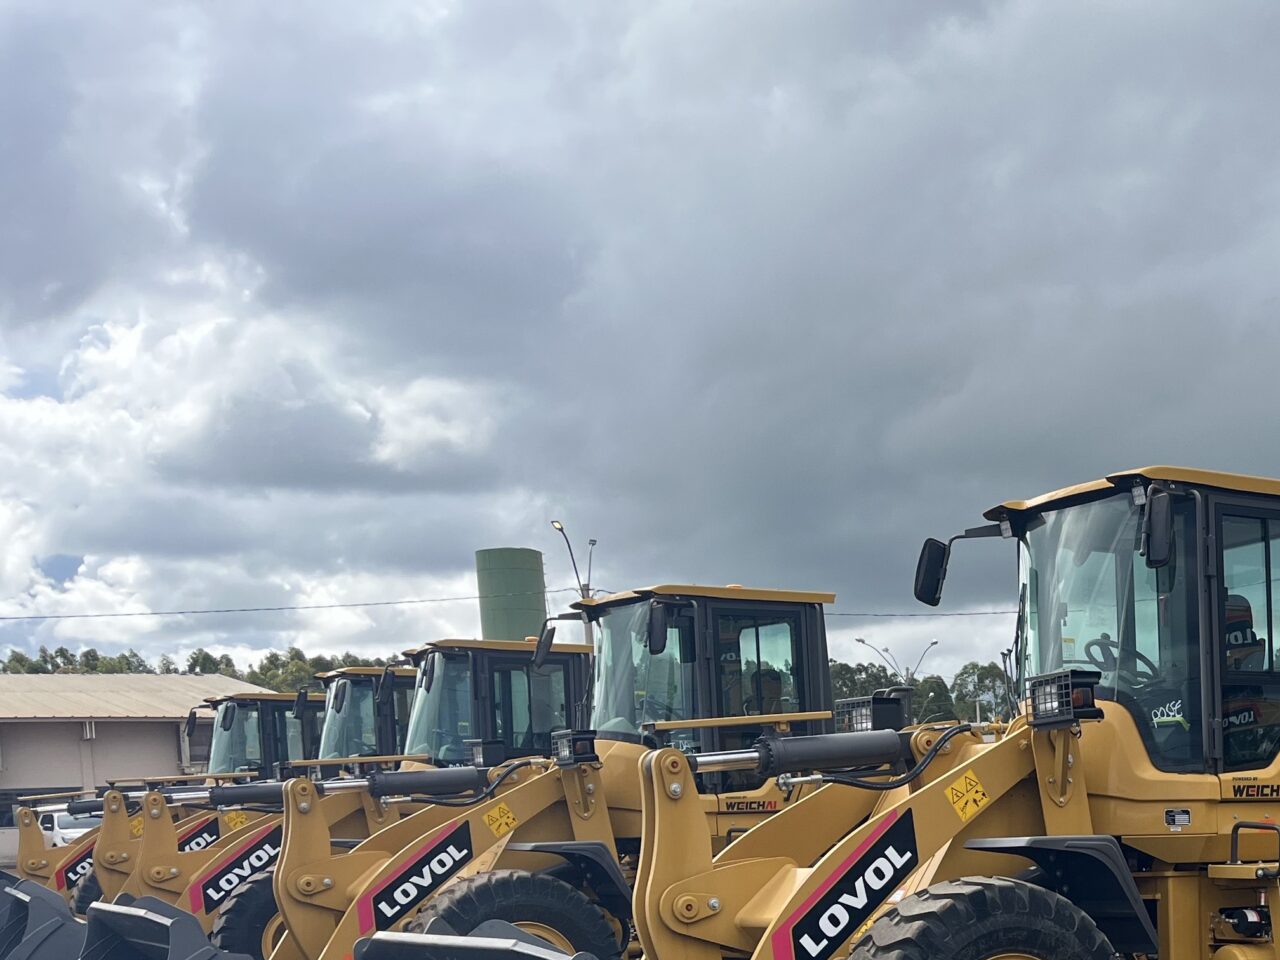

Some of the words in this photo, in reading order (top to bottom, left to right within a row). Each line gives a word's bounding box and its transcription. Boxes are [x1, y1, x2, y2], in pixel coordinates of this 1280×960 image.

[725, 800, 777, 811] WEICHAI
[206, 843, 282, 901] LOVOL
[377, 844, 468, 918] LOVOL
[798, 845, 913, 958] LOVOL
